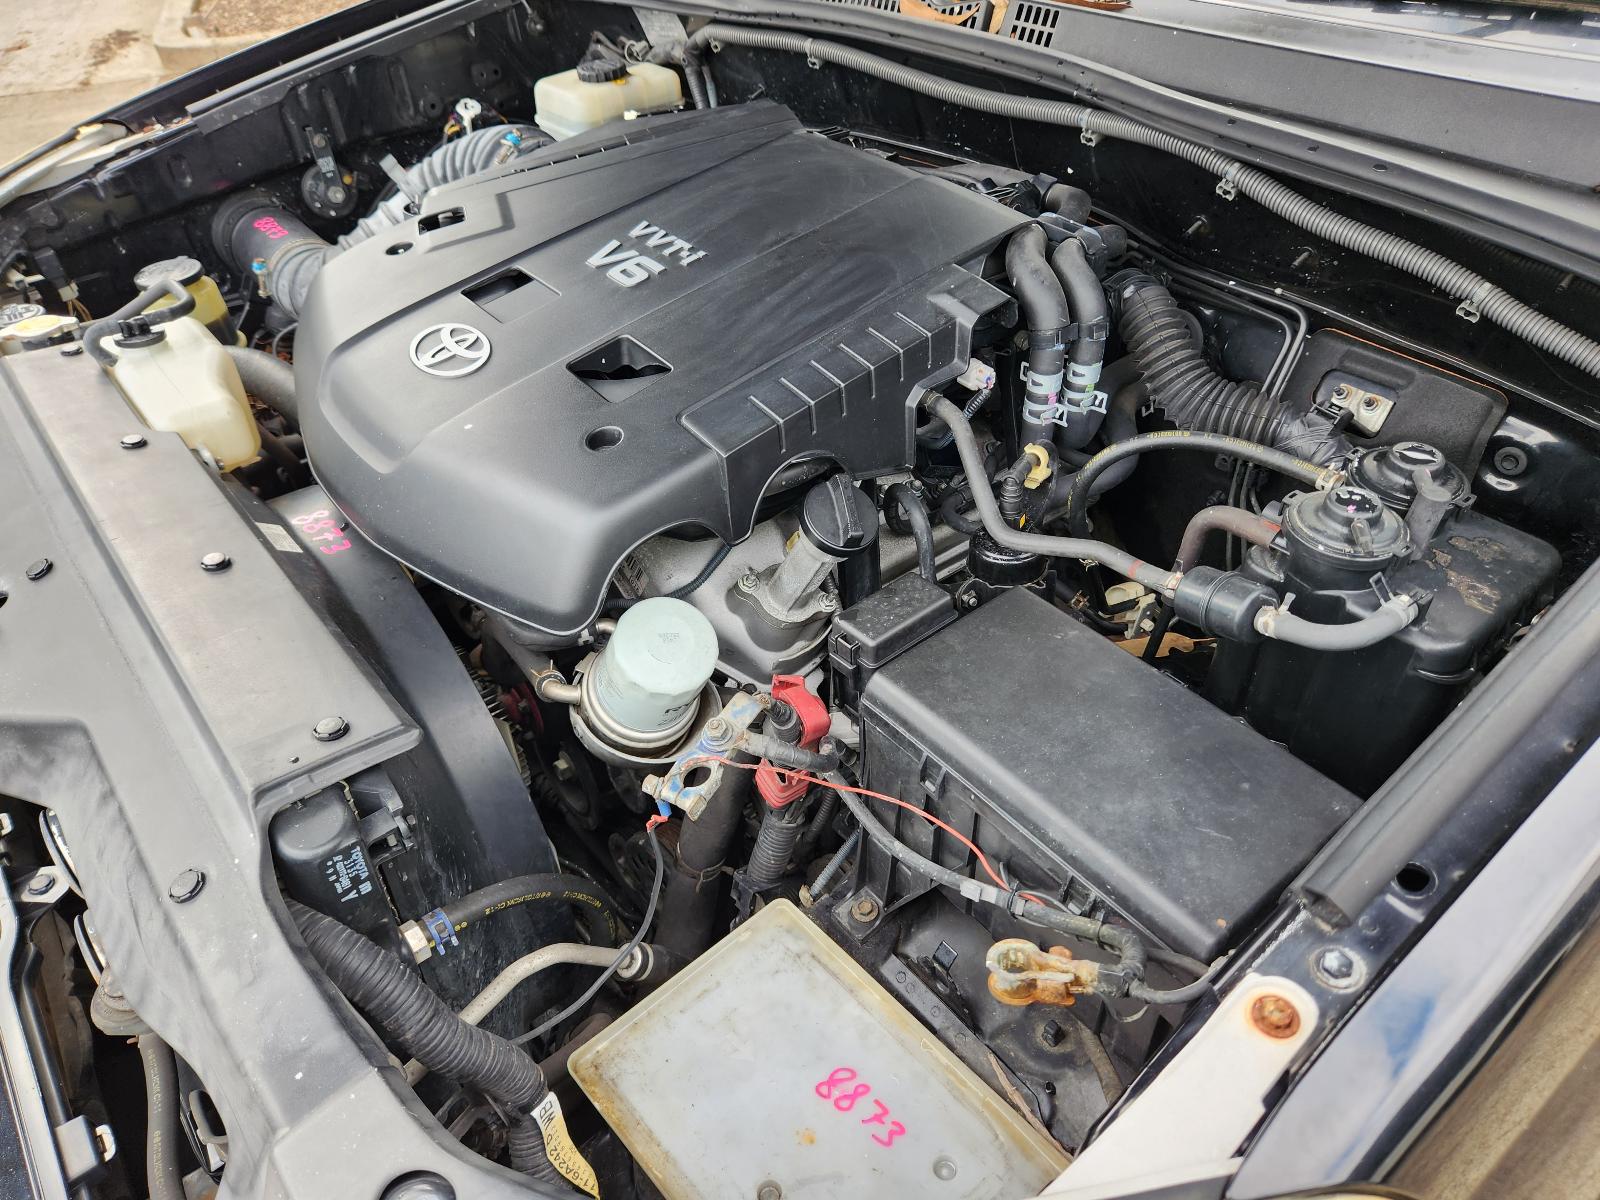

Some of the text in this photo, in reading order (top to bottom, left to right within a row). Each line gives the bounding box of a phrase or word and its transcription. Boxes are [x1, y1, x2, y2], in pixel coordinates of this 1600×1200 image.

[585, 239, 668, 288] V6
[291, 510, 353, 555] 8873
[351, 845, 370, 880] TOYOTA
[815, 1067, 906, 1148] 8873
